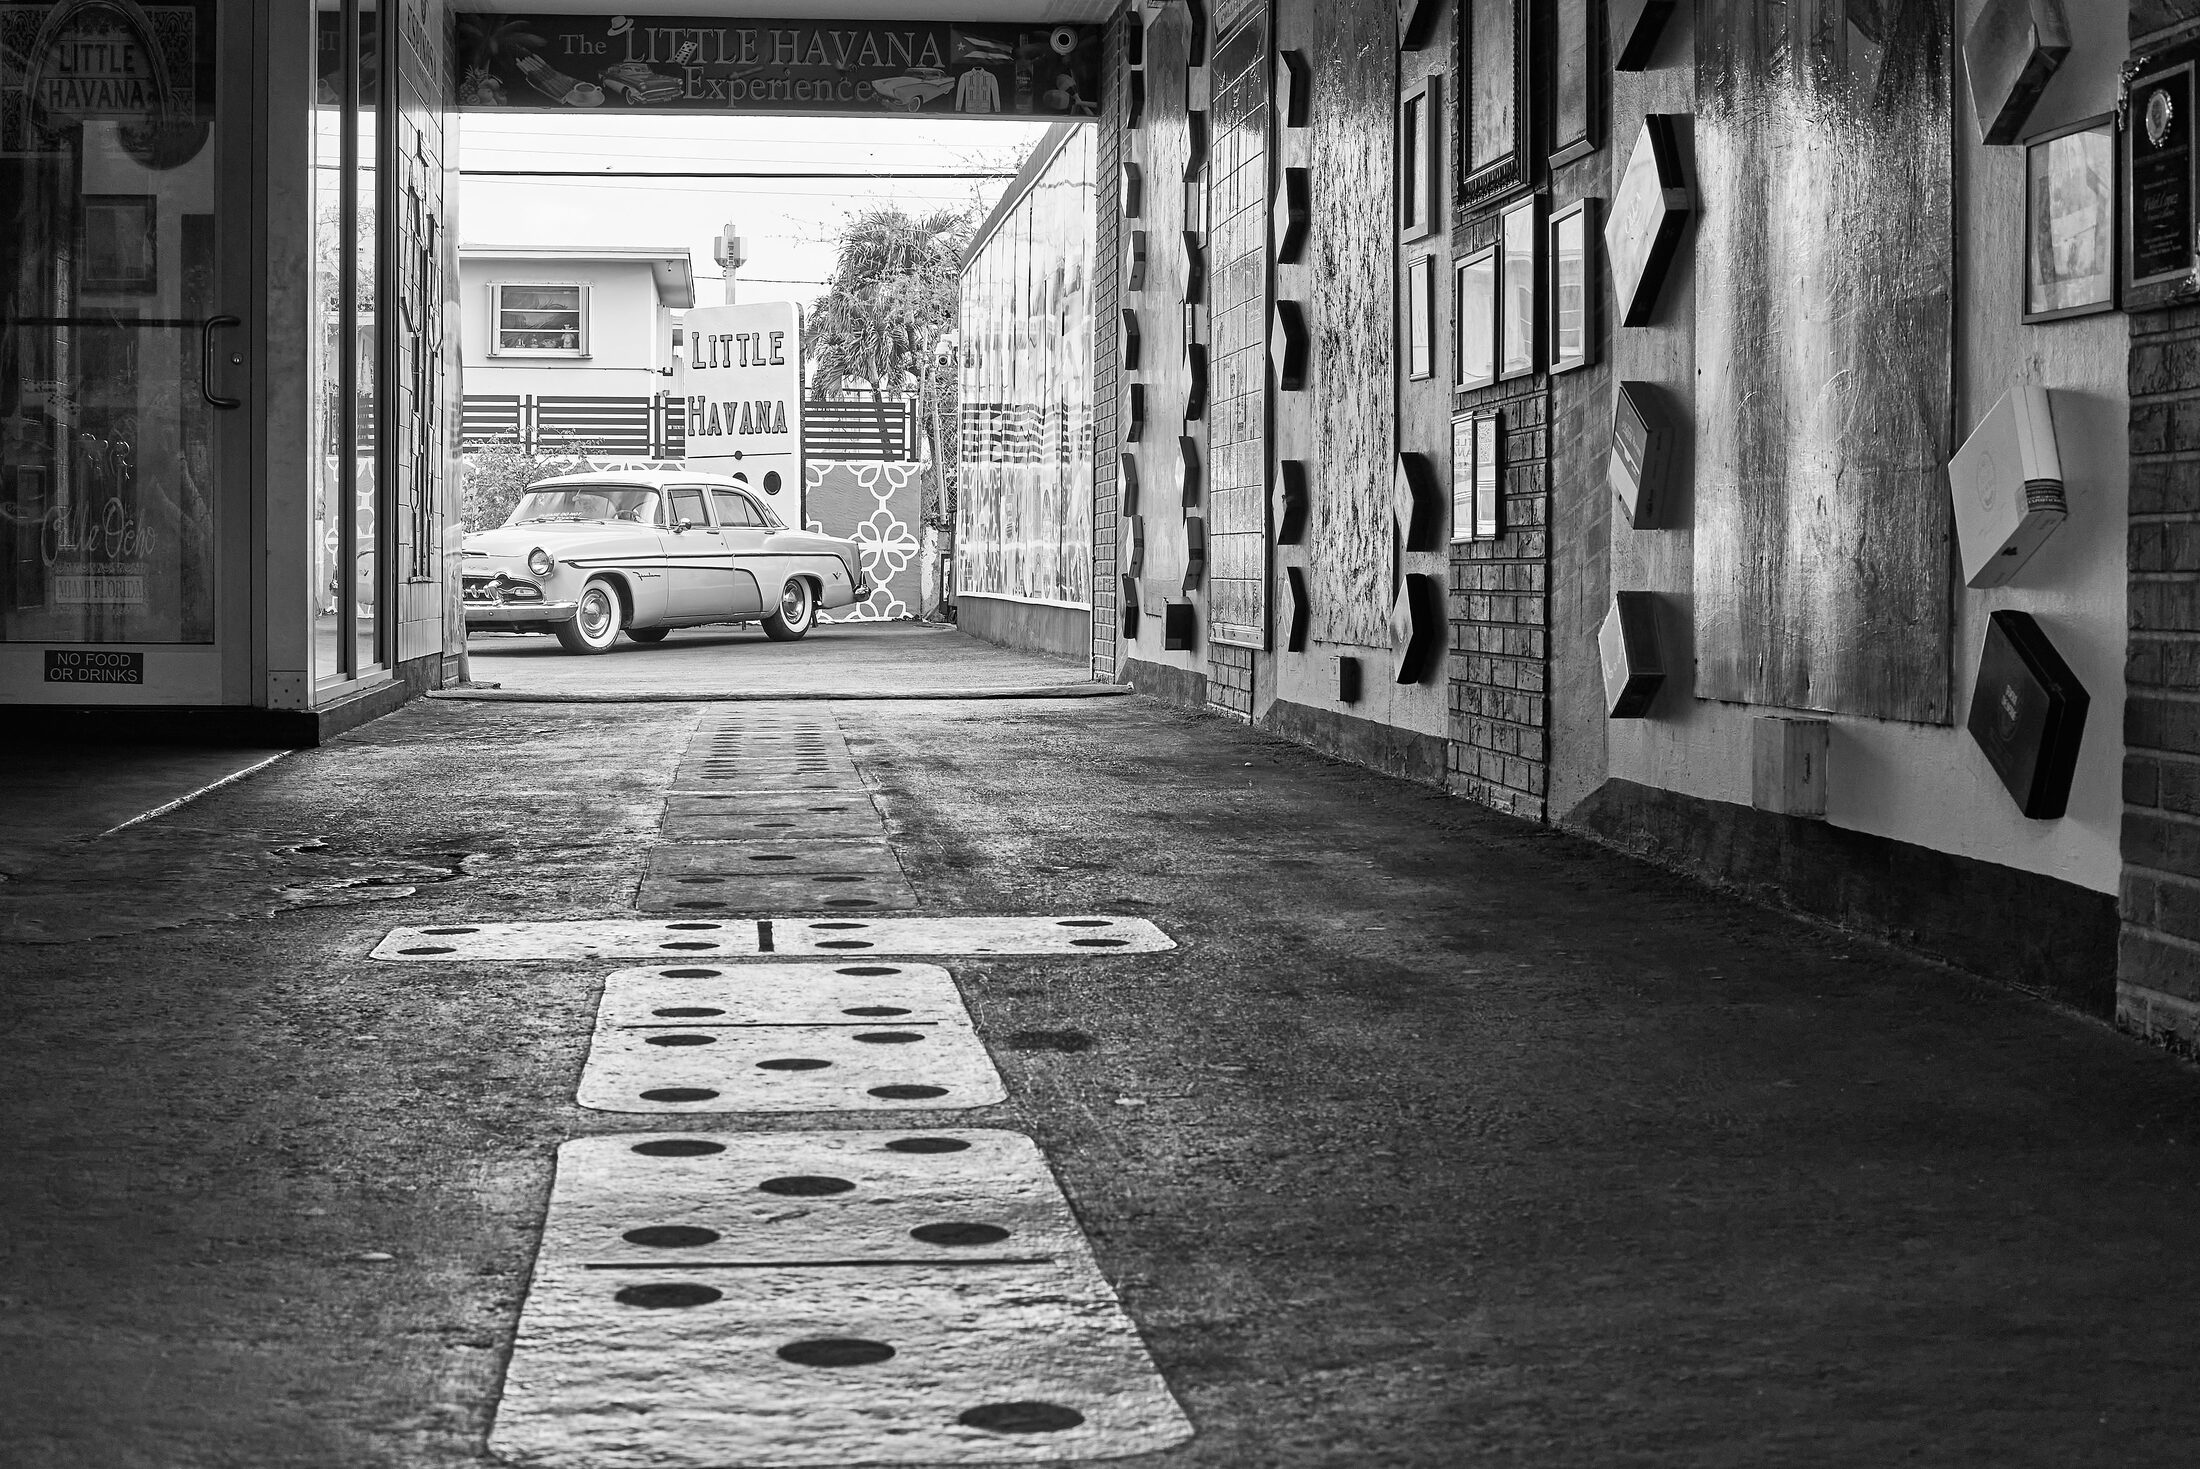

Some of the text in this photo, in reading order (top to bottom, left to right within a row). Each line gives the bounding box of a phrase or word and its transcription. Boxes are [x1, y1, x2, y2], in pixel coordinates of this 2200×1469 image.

[59, 44, 135, 74] LITTLE
[559, 27, 946, 68] The LITTLE HAVANA
[48, 80, 145, 107] HAVANA
[682, 66, 872, 108] Experience
[692, 331, 785, 369] LITTLE
[688, 395, 788, 437] HAVANA
[41, 497, 156, 568] Calle Ocho
[93, 580, 142, 598] FLORIDA
[50, 667, 138, 682] OR DRINKS
[57, 653, 131, 667] NO FOOD
